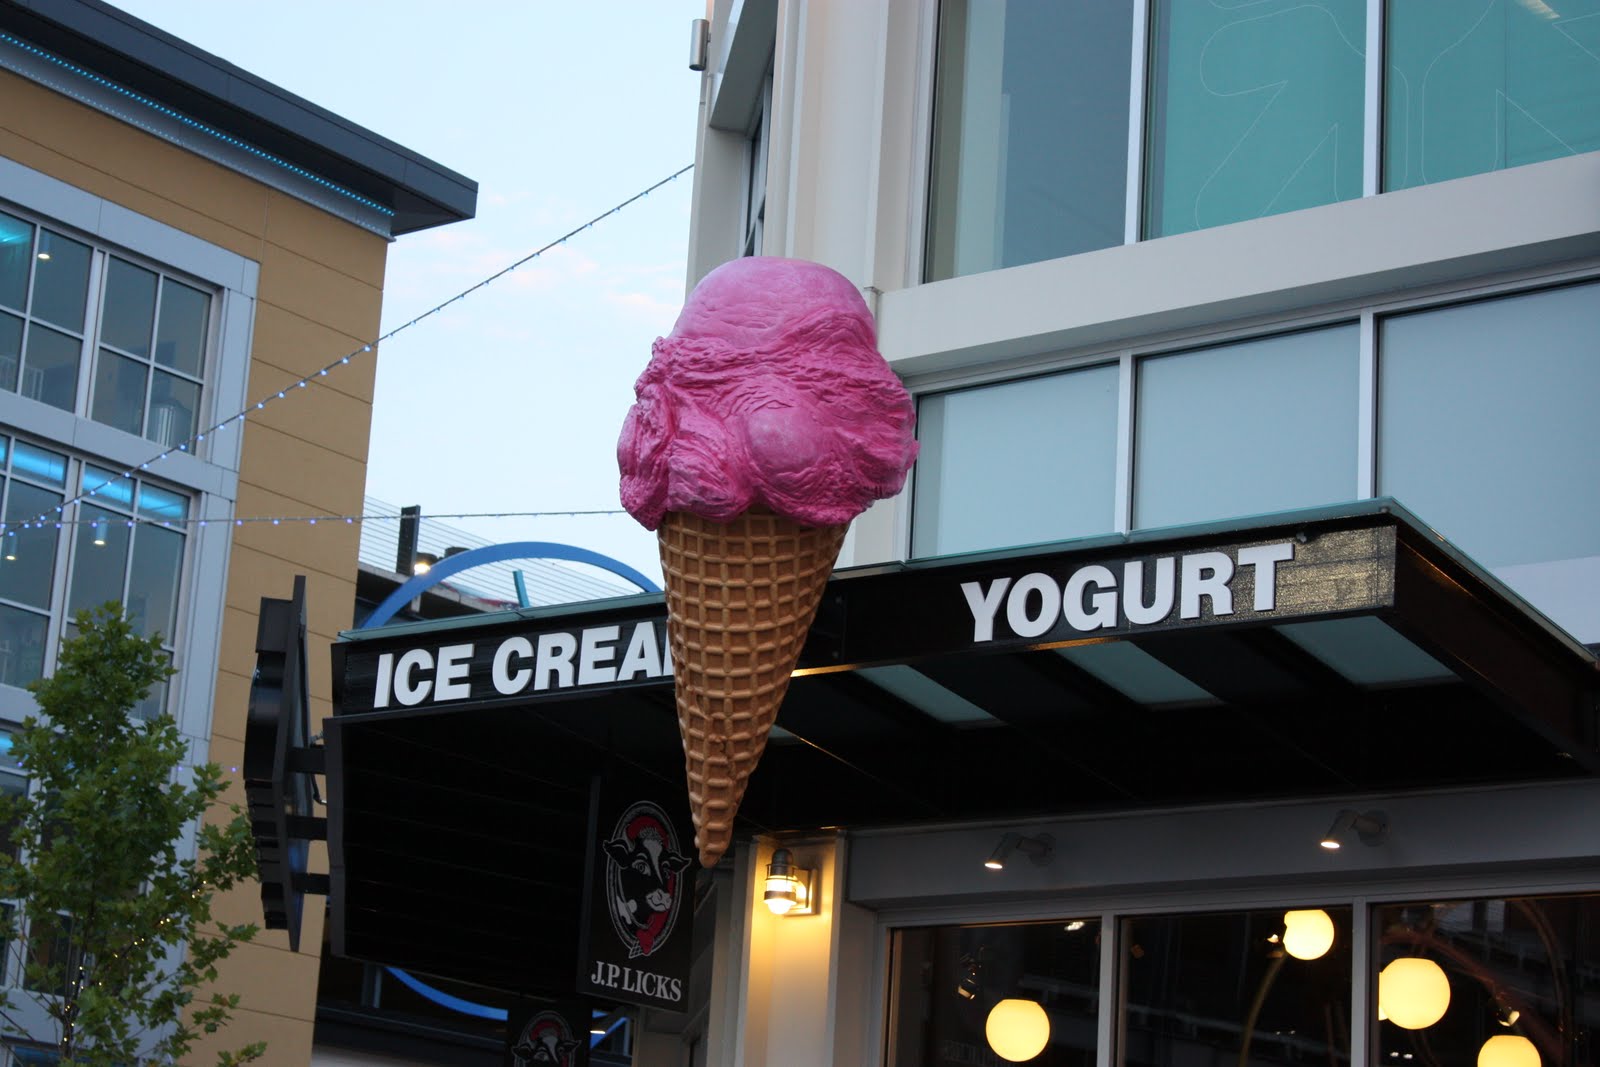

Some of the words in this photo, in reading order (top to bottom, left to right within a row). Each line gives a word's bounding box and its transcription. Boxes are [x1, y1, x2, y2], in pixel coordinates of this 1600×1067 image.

[960, 543, 1294, 643] YOGURT
[374, 643, 475, 708] ICE
[492, 621, 674, 695] CREA
[621, 967, 682, 1002] LICKS
